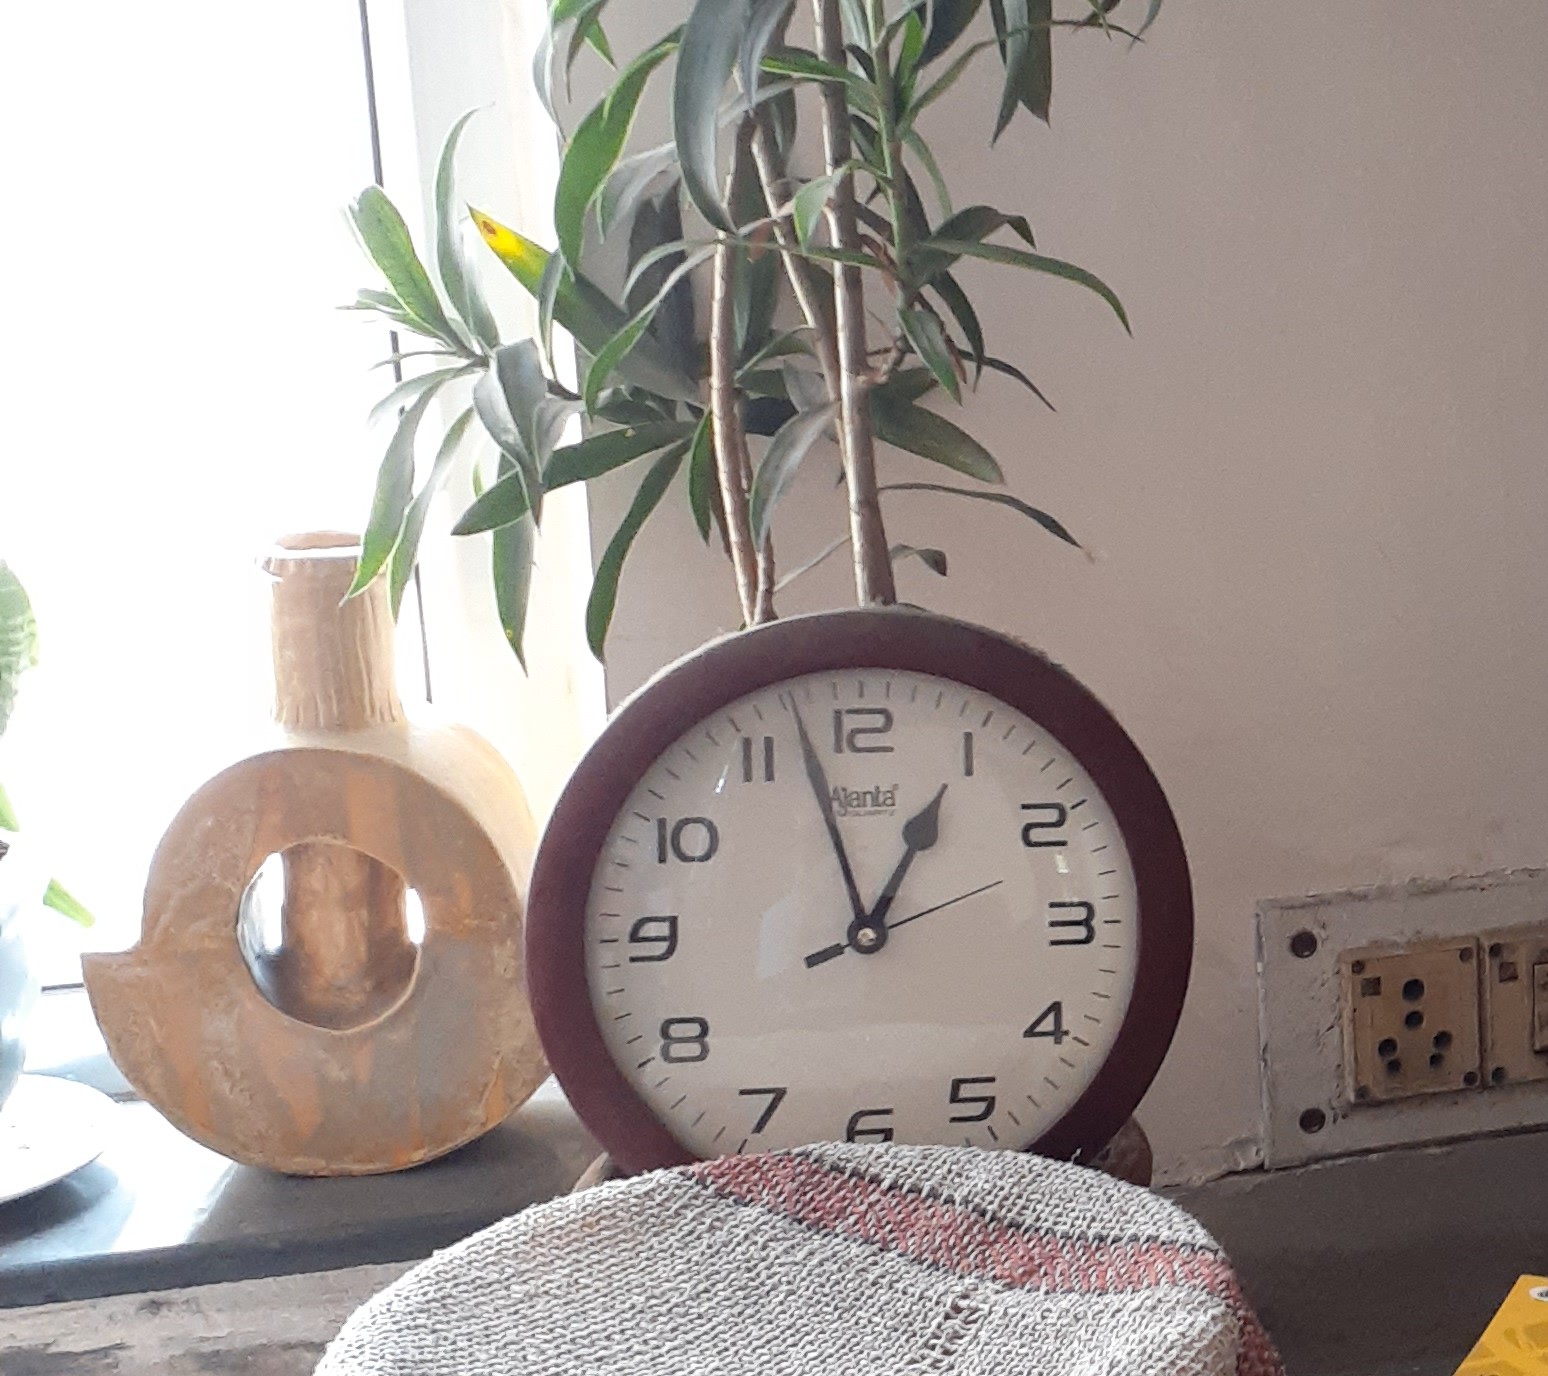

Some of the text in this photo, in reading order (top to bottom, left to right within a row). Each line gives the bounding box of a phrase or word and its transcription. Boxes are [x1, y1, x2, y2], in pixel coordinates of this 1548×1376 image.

[833, 707, 895, 754] 12
[962, 730, 975, 777] 1
[741, 735, 775, 783] 11
[656, 816, 719, 864] 10
[1020, 802, 1068, 848] 2
[628, 914, 680, 964] 9
[1048, 901, 1096, 947] 3
[659, 1016, 710, 1064] 8
[1022, 1001, 1070, 1046] 4
[739, 1087, 788, 1135] 7
[949, 1076, 997, 1124] 5
[845, 1108, 895, 1143] 6
